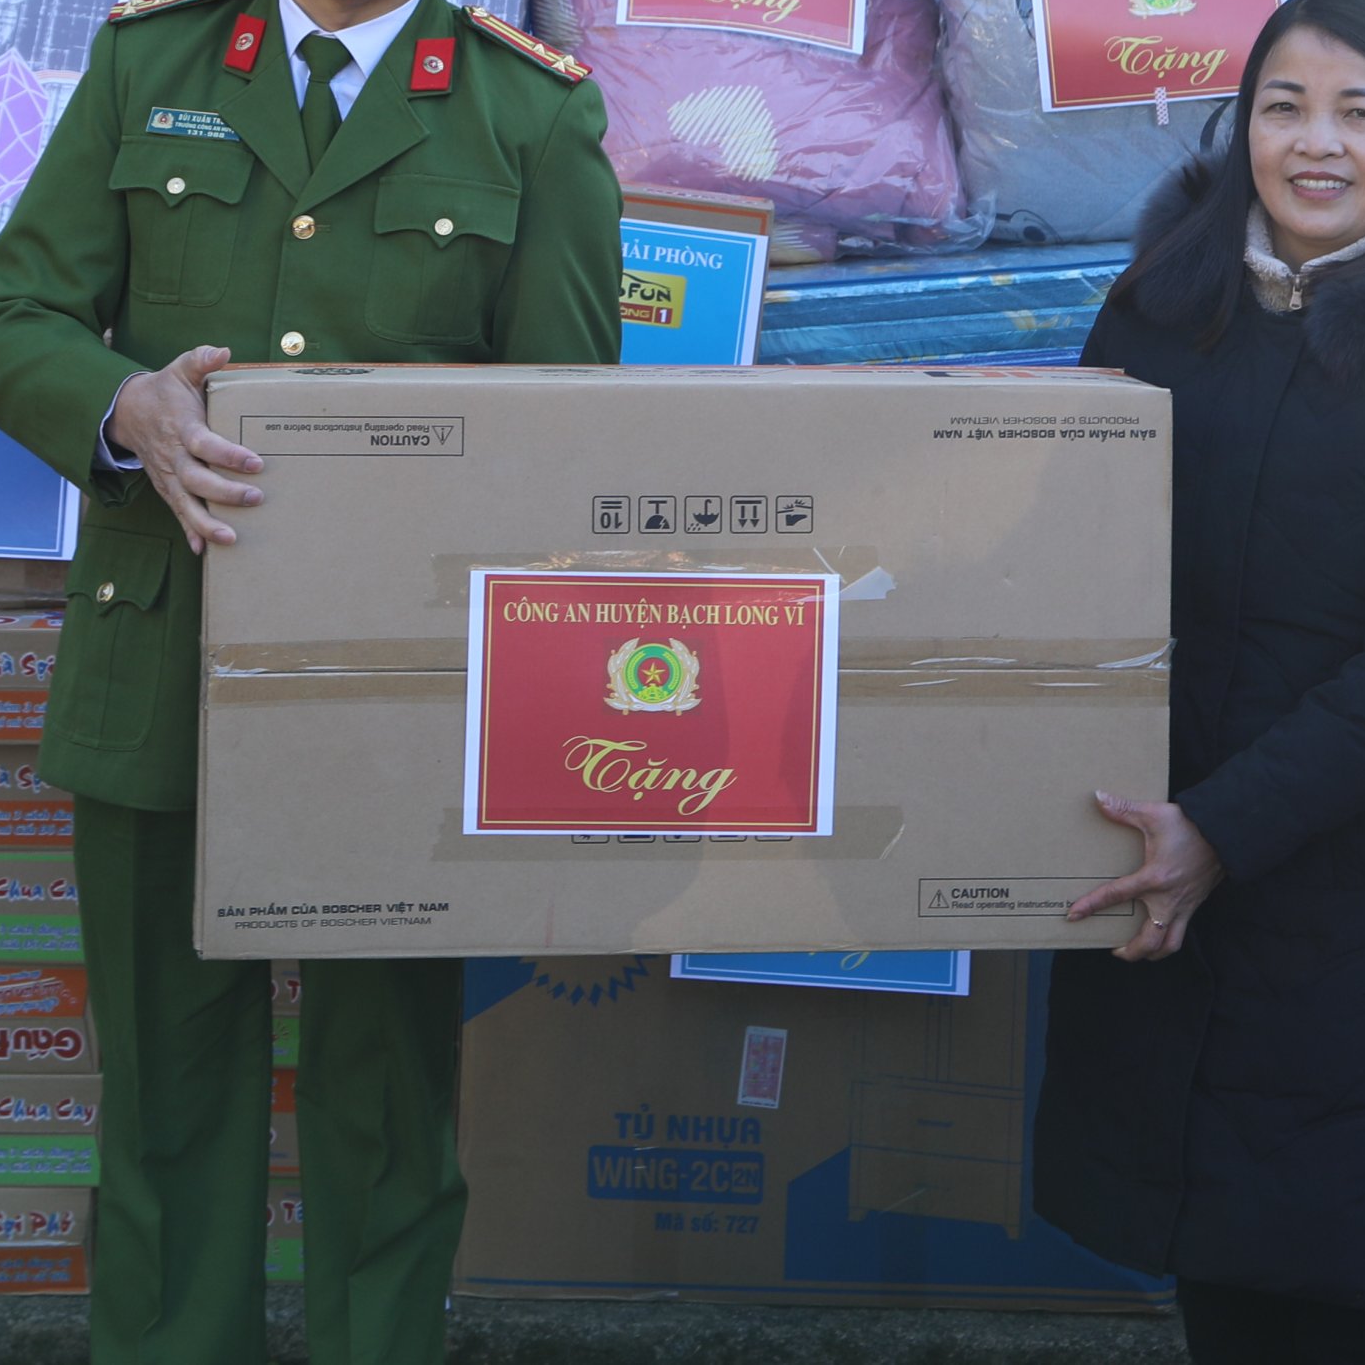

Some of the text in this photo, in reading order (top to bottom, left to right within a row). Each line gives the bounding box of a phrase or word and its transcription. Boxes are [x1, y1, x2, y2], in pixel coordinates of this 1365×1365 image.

[1104, 35, 1229, 86] Tặng
[654, 245, 723, 270] PHÒNG
[265, 423, 430, 434] Read operating instructions before use
[933, 429, 963, 439] NAM
[998, 429, 1056, 439] BOSCHER
[1060, 429, 1085, 441] CỦA
[370, 435, 430, 446] CAUTION
[1089, 429, 1125, 442] PHẨM
[1130, 430, 1157, 441] SẢN
[503, 597, 805, 630] CÔNG AN HUYỆN BẠCH LONG VĨ
[562, 735, 738, 816] Tặng
[951, 888, 1009, 899] CAUTION
[218, 901, 450, 918] SẢN PHẨM CỦA BOSCHER VIỆT NAM
[951, 900, 1065, 911] Read operating instructions
[235, 916, 432, 930] PRODUCTS OF BOSCHER VIETNAM
[614, 1104, 761, 1150] TỦ NHỰA
[655, 1212, 684, 1233] Mã
[726, 1213, 761, 1236] 727
